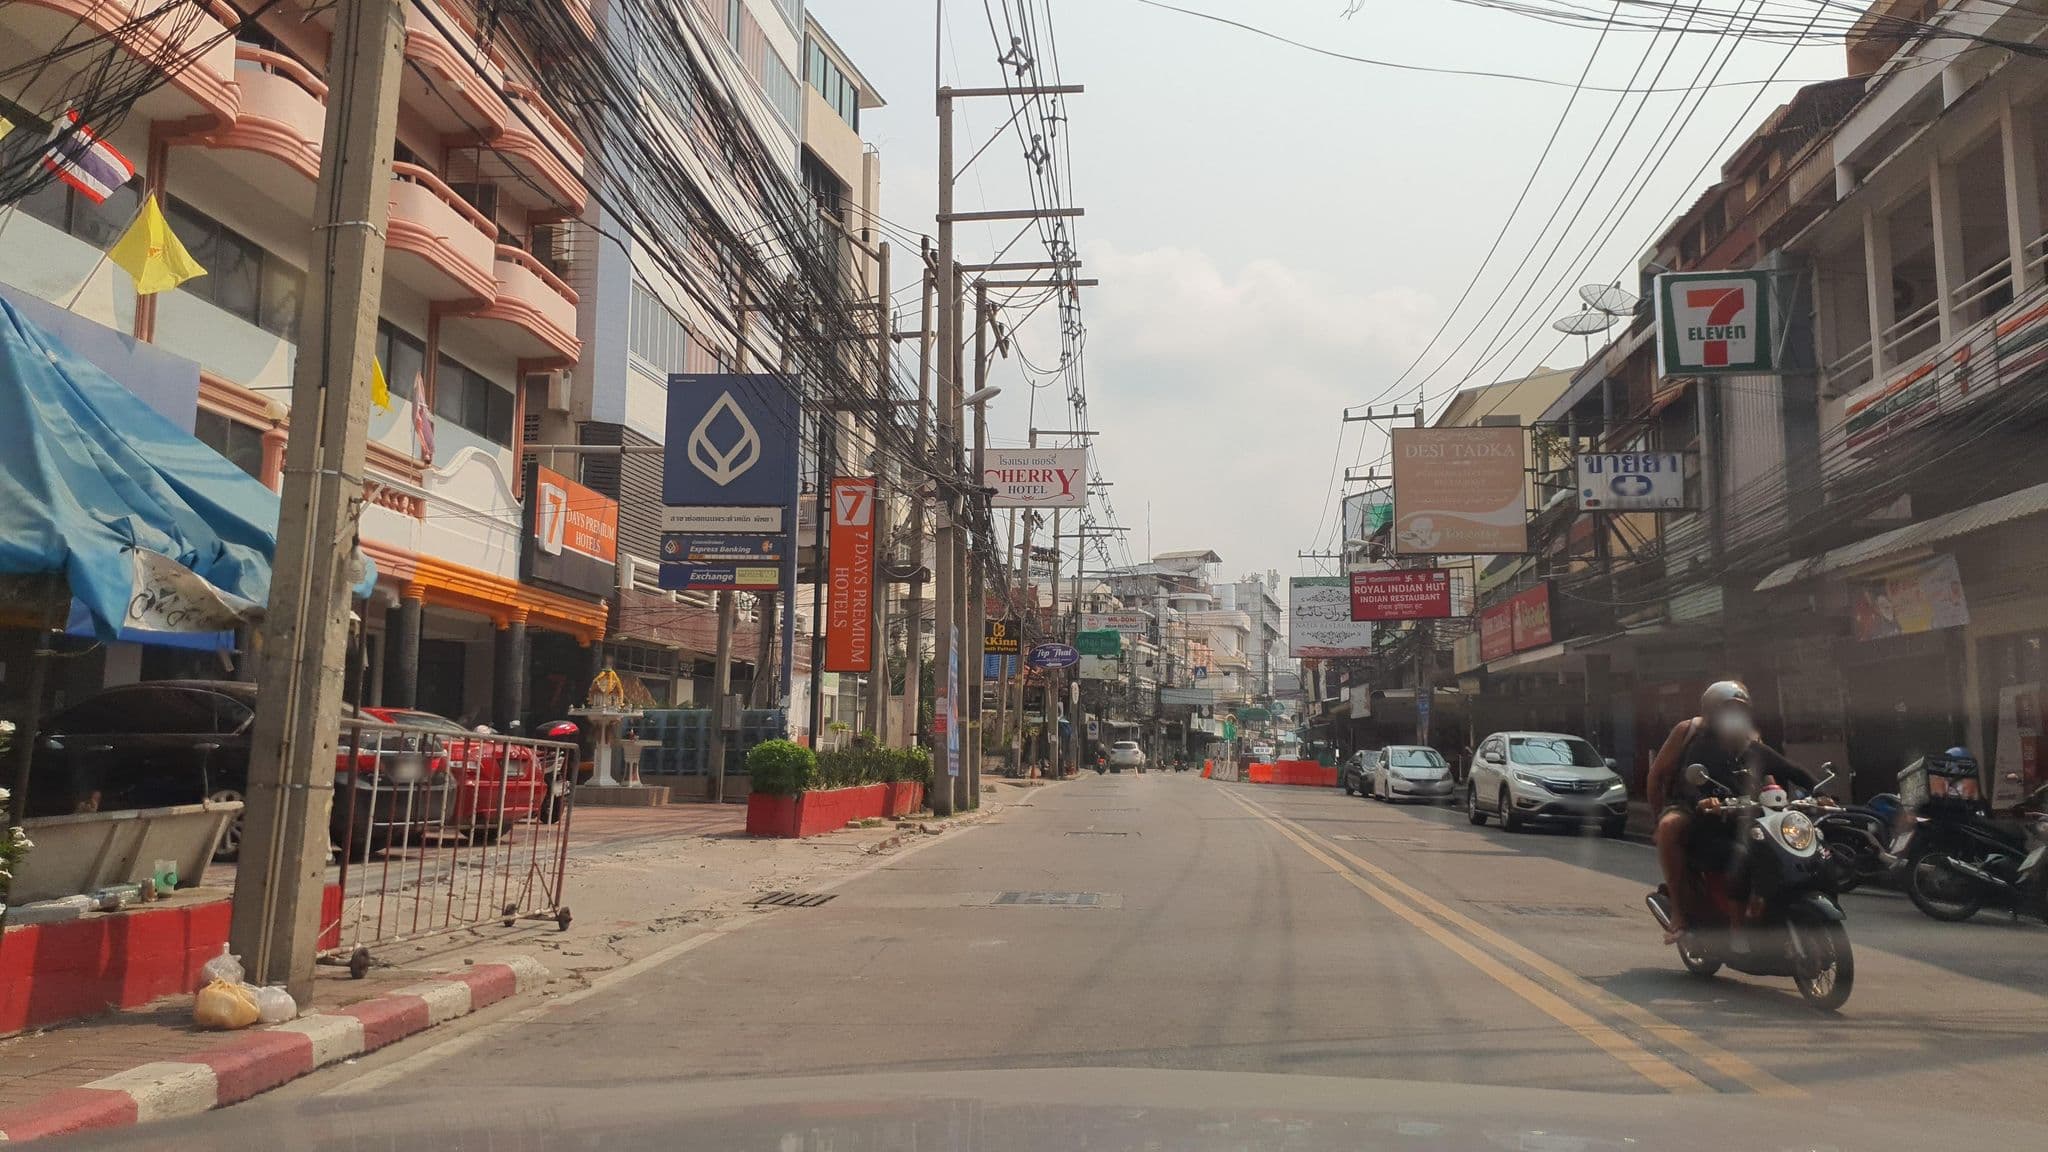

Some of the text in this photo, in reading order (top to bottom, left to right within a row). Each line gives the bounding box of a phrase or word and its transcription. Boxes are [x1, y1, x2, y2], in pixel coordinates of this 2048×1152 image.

[1686, 288, 1744, 365] 7
[1406, 443, 1515, 457] DESI TADKA
[1008, 485, 1048, 494] HOTEL
[842, 490, 867, 520] 7
[548, 492, 562, 544] 7
[567, 509, 615, 540] DAYS PREMIUM
[576, 531, 601, 552] HOTELS
[690, 546, 751, 555] Express Banking
[690, 572, 734, 582] Exchange
[1354, 585, 1385, 594] ROYAL
[1388, 583, 1422, 593] INDIAN
[1426, 582, 1446, 592] HUT
[834, 567, 849, 628] HOTELS
[851, 531, 868, 663] 7 DAYS PREMIUM
[1360, 594, 1440, 603] INDIAN RESTAURANT
[1037, 648, 1050, 658] Top
